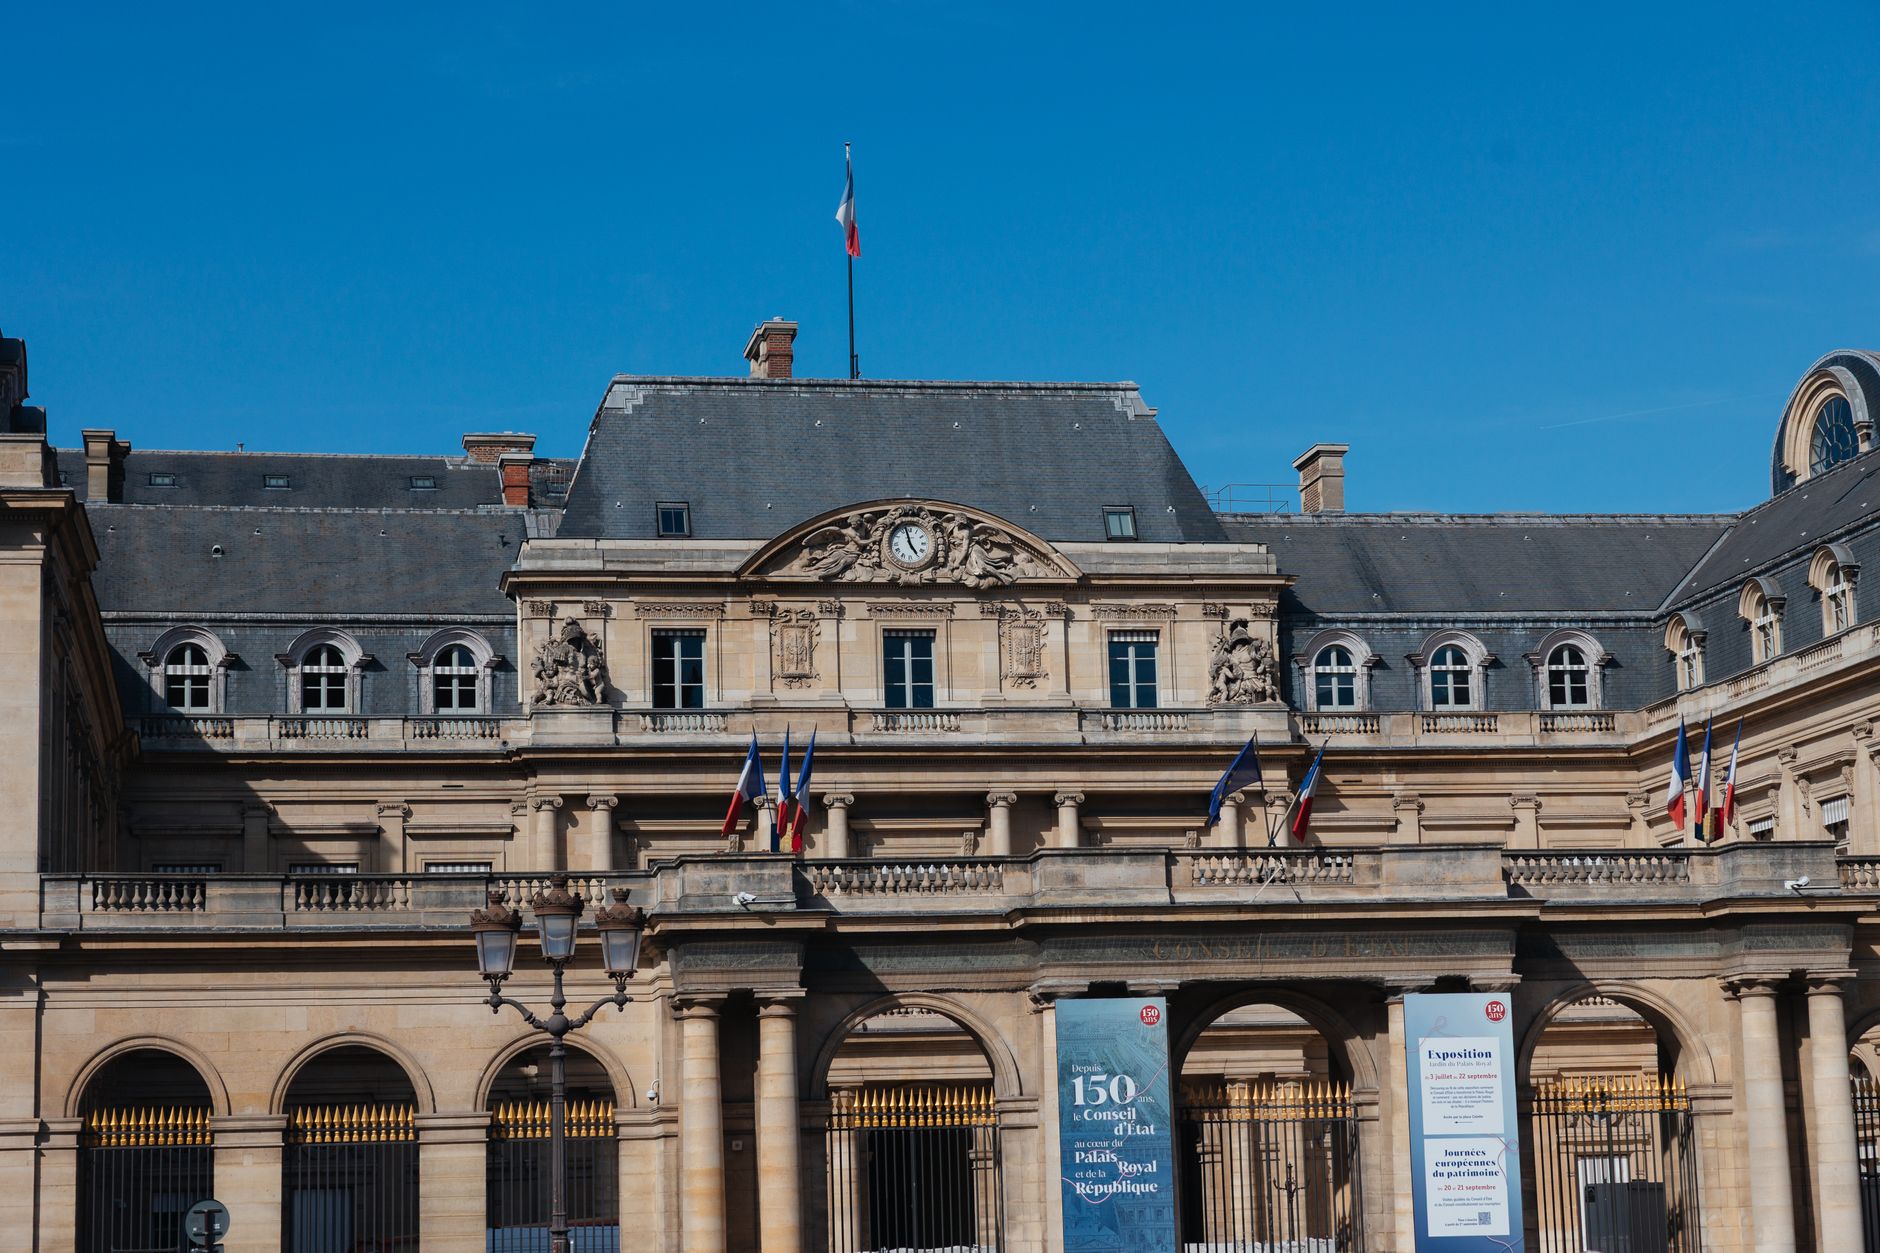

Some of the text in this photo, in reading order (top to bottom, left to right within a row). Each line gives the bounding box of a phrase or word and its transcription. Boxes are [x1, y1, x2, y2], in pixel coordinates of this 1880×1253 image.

[1152, 939, 1281, 960] CONSEIL
[1428, 1048, 1492, 1061] Exposition
[1072, 1064, 1101, 1073] Depuis
[1435, 1073, 1453, 1081] juillet
[1072, 1073, 1136, 1106] 150
[1073, 1107, 1137, 1121] le Conseil
[1086, 1140, 1109, 1148] cœur
[1111, 1138, 1123, 1148] du
[1444, 1148, 1486, 1157] Journées
[1119, 1160, 1157, 1176] Royal
[1435, 1158, 1496, 1169] européennes
[1085, 1170, 1096, 1178] de
[1098, 1169, 1106, 1178] la
[1447, 1168, 1500, 1179] patrimoine
[1076, 1180, 1158, 1196] République
